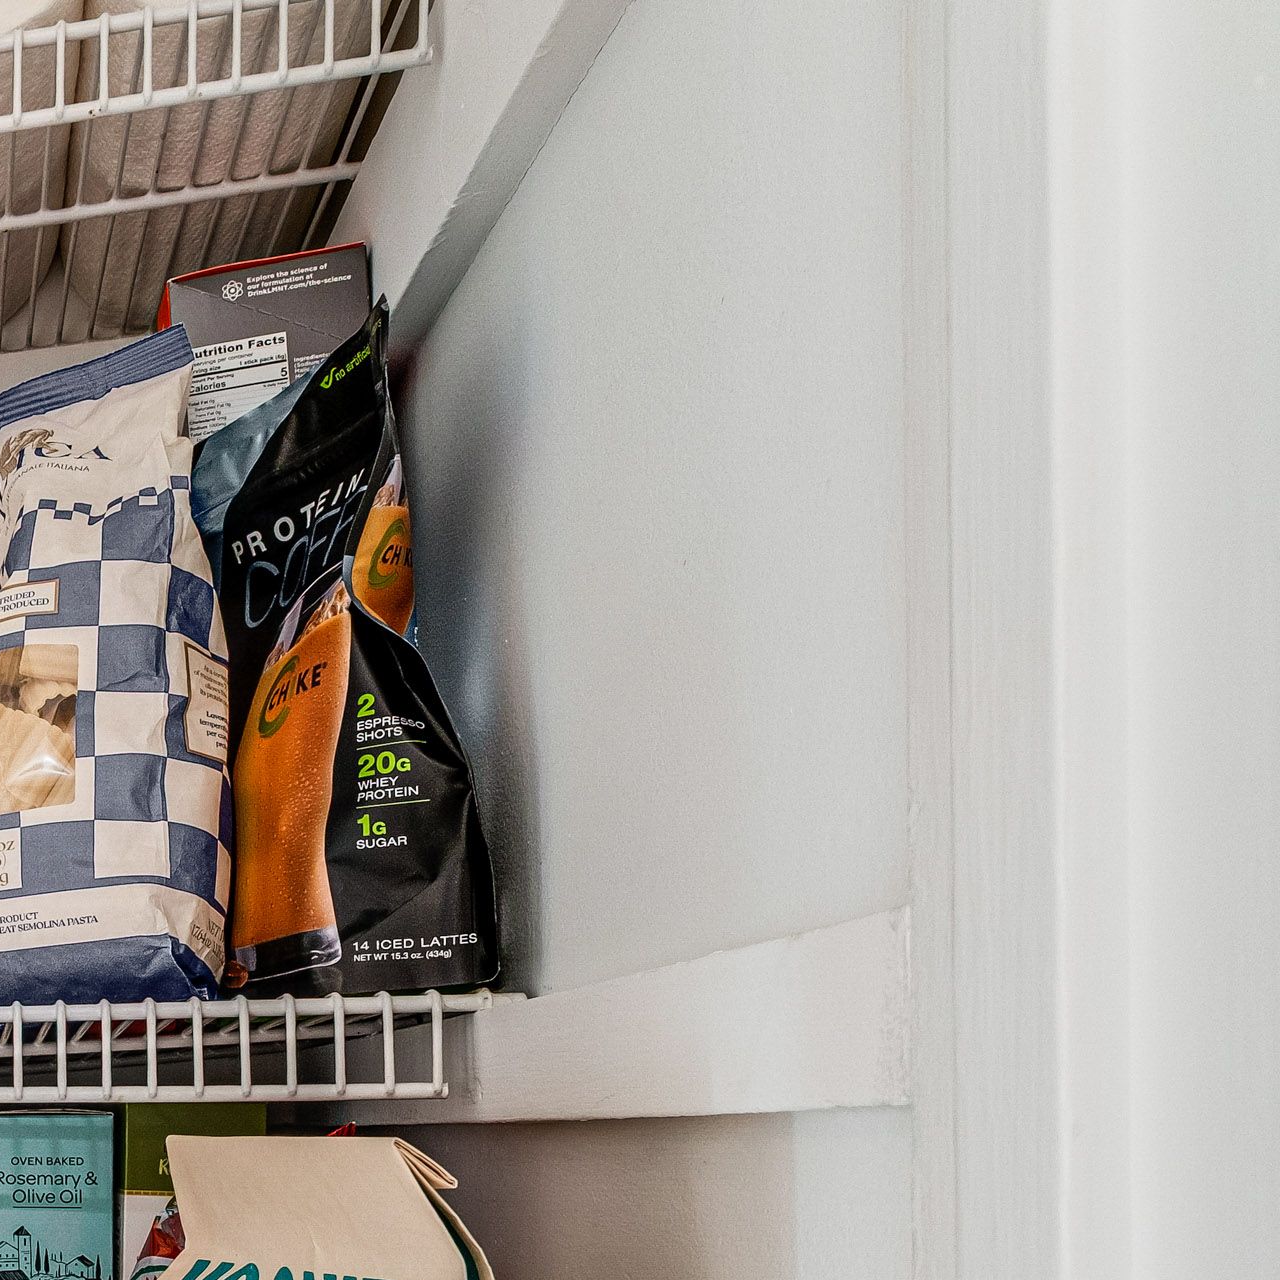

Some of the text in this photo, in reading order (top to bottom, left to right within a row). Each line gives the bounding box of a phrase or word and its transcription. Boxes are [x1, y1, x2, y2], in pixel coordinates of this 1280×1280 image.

[247, 274, 274, 283] Explore
[290, 266, 318, 276] science
[247, 282, 260, 290] our
[261, 275, 303, 287] formulation
[232, 468, 369, 564] PROTEIN
[357, 693, 375, 718] 2
[356, 716, 425, 731] ESPRESSO
[356, 726, 402, 742] SHOTS
[358, 751, 411, 778] 20G
[358, 776, 399, 791] WHEY
[357, 785, 419, 802] PROTEIN
[357, 814, 387, 836] 1G
[356, 836, 408, 850] SUGAR
[17, 919, 65, 934] SEMOLINA
[67, 915, 98, 925] PASTA
[353, 932, 478, 951] 14 ICED LATTES
[11, 1156, 84, 1166] OVEN BAKED
[84, 1171, 99, 1186] &
[12, 1189, 83, 1204] Olive Oil
